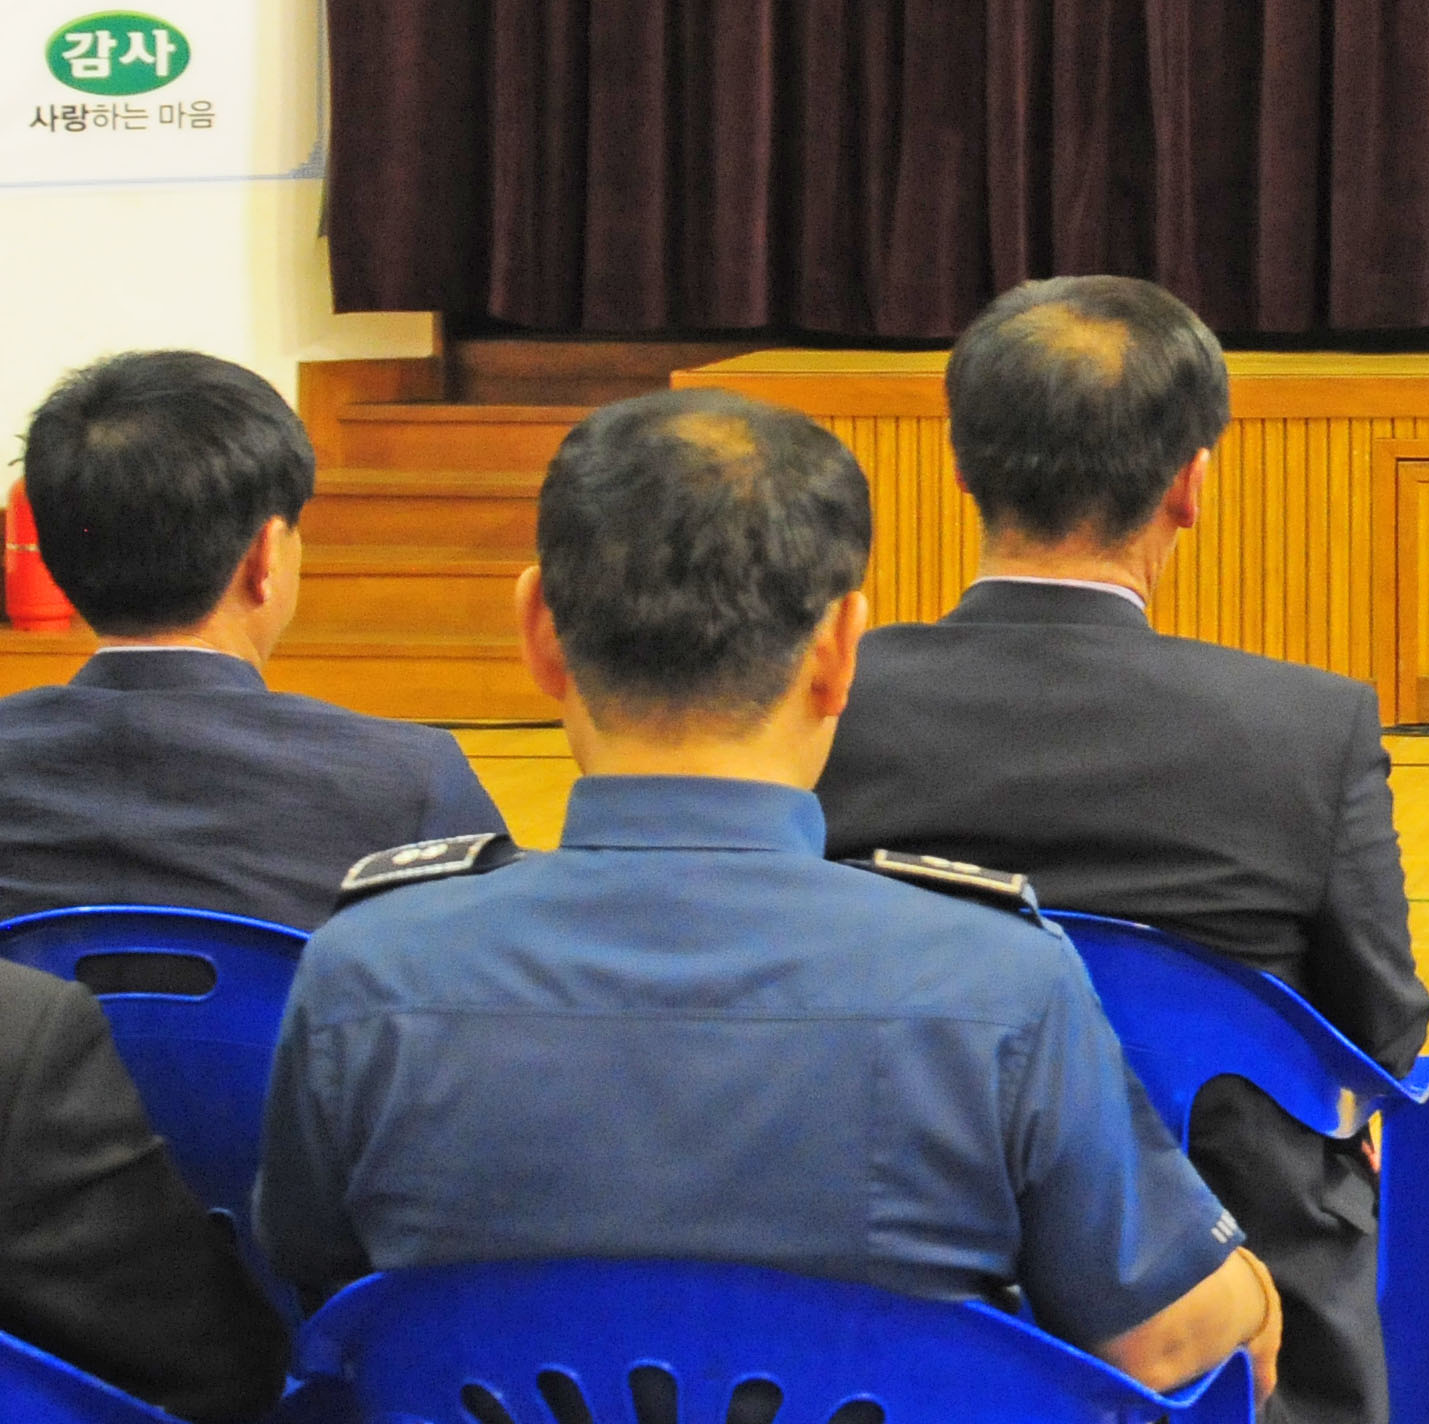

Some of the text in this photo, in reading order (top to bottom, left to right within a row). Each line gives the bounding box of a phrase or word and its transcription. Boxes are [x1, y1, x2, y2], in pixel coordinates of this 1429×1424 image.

[61, 29, 177, 78] 감사
[29, 100, 216, 133] 사랑하는 마음
